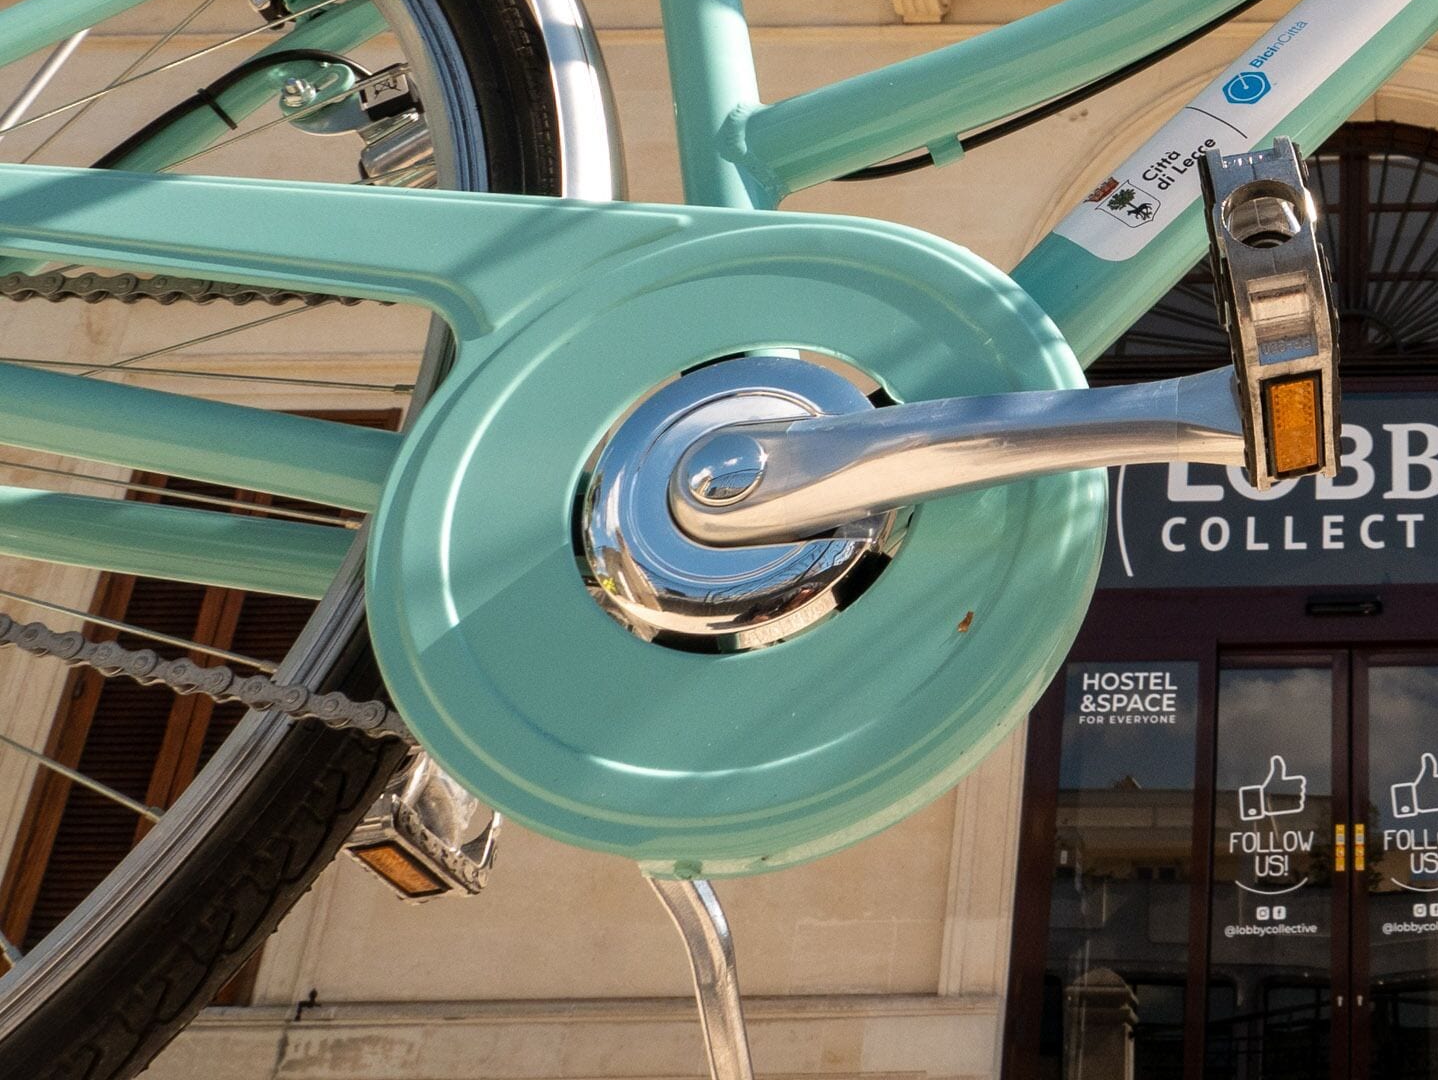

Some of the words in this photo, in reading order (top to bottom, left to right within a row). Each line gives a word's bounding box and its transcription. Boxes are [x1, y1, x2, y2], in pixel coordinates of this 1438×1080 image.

[1142, 150, 1181, 181] Città
[1157, 173, 1175, 190] di
[1171, 138, 1216, 175] Lecce
[1082, 672, 1179, 691] HOSTEL
[1080, 693, 1177, 713] &SPACE
[1079, 715, 1104, 724] FOR
[1109, 714, 1177, 724] EVERYONE
[1229, 830, 1314, 854] FOLLOW
[1255, 854, 1289, 877] US!
[1224, 923, 1318, 938] @lobbycollective
